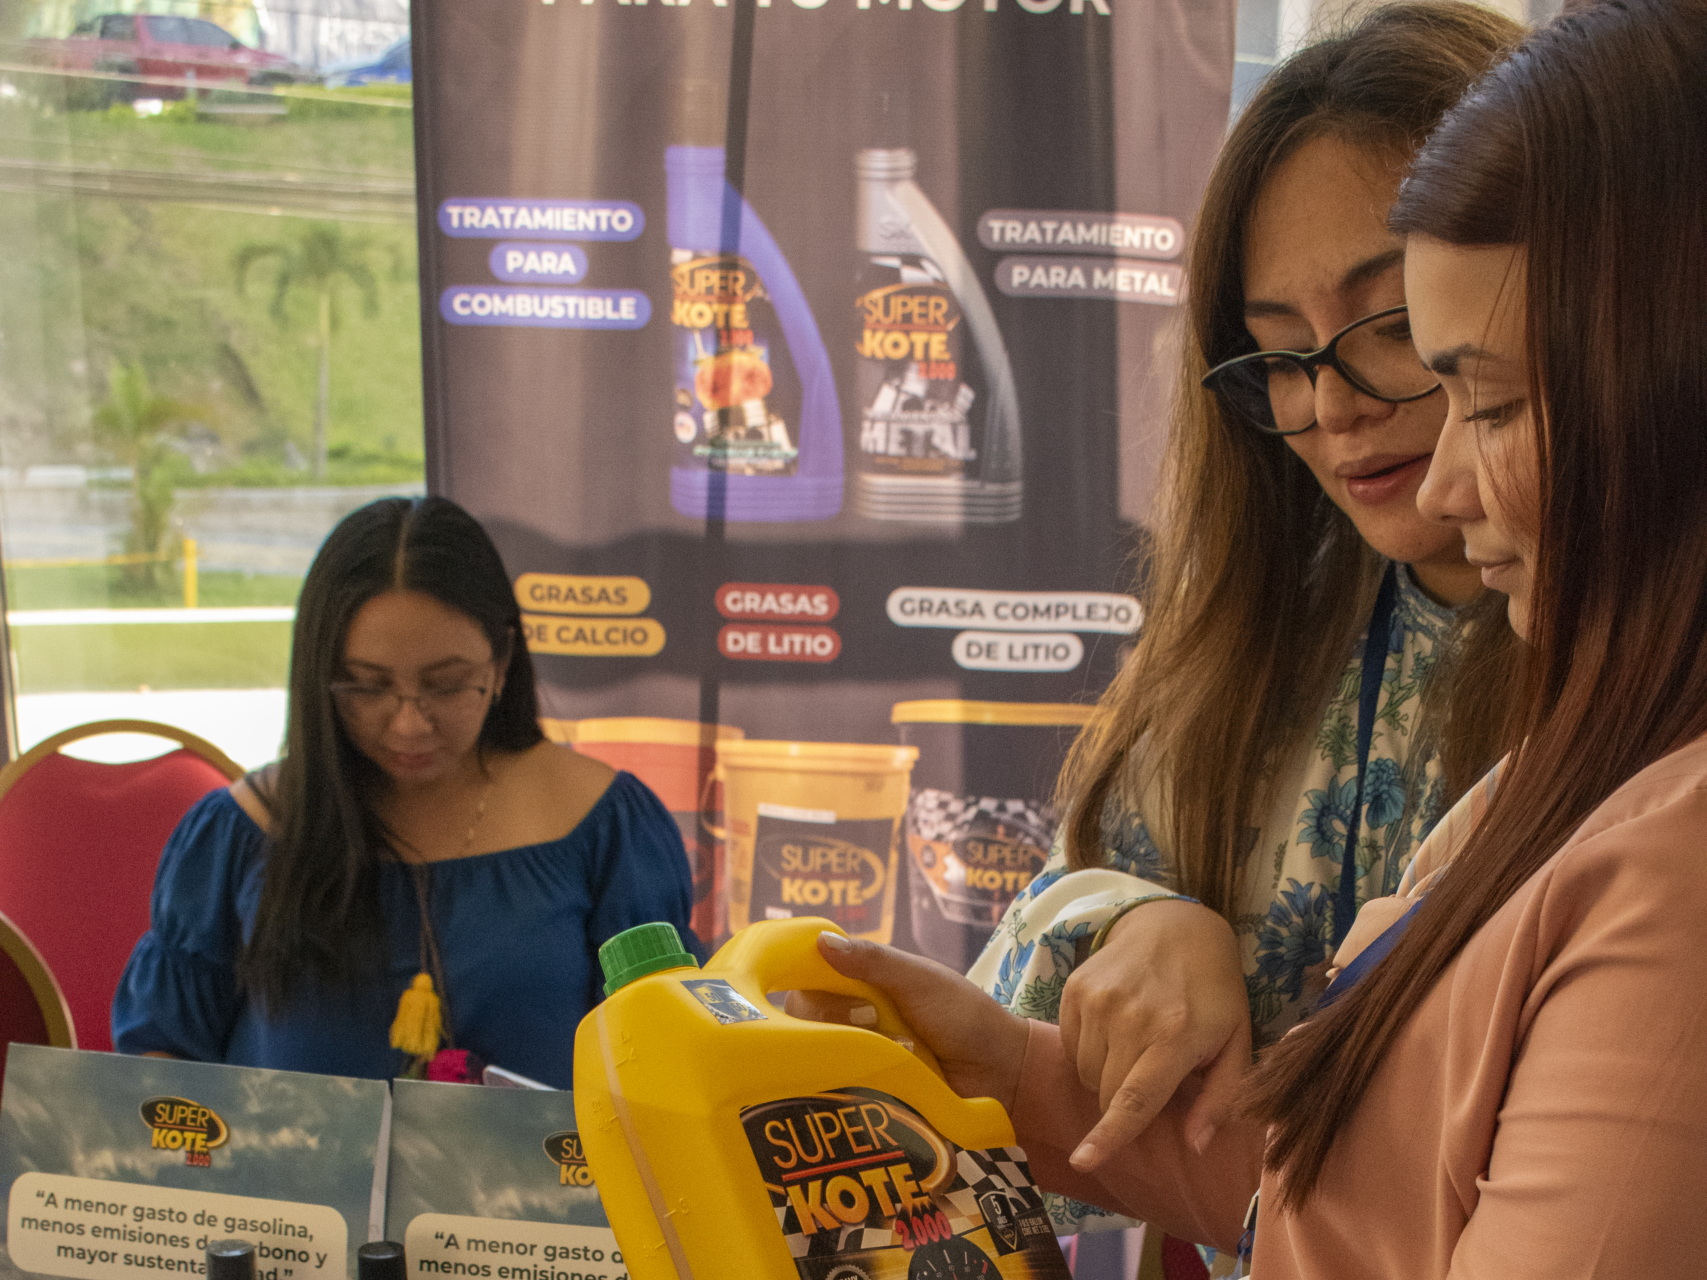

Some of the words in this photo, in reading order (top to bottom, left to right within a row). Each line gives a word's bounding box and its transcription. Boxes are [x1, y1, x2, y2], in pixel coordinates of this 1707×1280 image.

[446, 205, 634, 232] TRATAMIENTO
[988, 219, 1175, 252] TRATAMIENTO
[506, 250, 577, 276] PARA
[672, 269, 746, 296] SUPER
[1011, 264, 1087, 289] PARA
[1093, 267, 1176, 297] METAL
[452, 293, 637, 320] COMBUSTIBLE
[672, 301, 750, 329] KOTE
[863, 295, 949, 325] SUPER
[863, 330, 951, 360] KOTE
[529, 583, 628, 606] GRASAS
[724, 591, 829, 616] GRASAS
[899, 597, 986, 618] GRASA
[994, 600, 1132, 624] COMPLEJO
[556, 626, 648, 647] CALCIO
[726, 632, 762, 653] DE
[768, 634, 835, 656] LITIO
[965, 641, 998, 661] DE
[1008, 642, 1071, 662] LITIO
[780, 845, 861, 873] SUPER
[967, 842, 1032, 868] SUPER
[782, 879, 865, 905] KOTE
[966, 867, 1032, 892] KOTE
[154, 1103, 212, 1127] SUPER
[151, 1128, 209, 1152] KOTE
[764, 1103, 899, 1169] SUPER
[559, 1164, 597, 1187] KO
[786, 1162, 931, 1237] KOTE
[989, 1194, 1002, 1215] 5
[64, 1196, 129, 1217] menor
[132, 1206, 187, 1223] gasto
[193, 1209, 217, 1227] de
[224, 1218, 314, 1243] gasolina,
[895, 1210, 953, 1250] 2.000
[21, 1216, 85, 1236] menos
[91, 1223, 190, 1250] emisiones
[258, 1241, 310, 1264] bono
[315, 1251, 328, 1269] y
[56, 1243, 118, 1267] mayor
[467, 1238, 538, 1257] menor
[543, 1244, 605, 1263] gasto
[418, 1258, 492, 1277] menos
